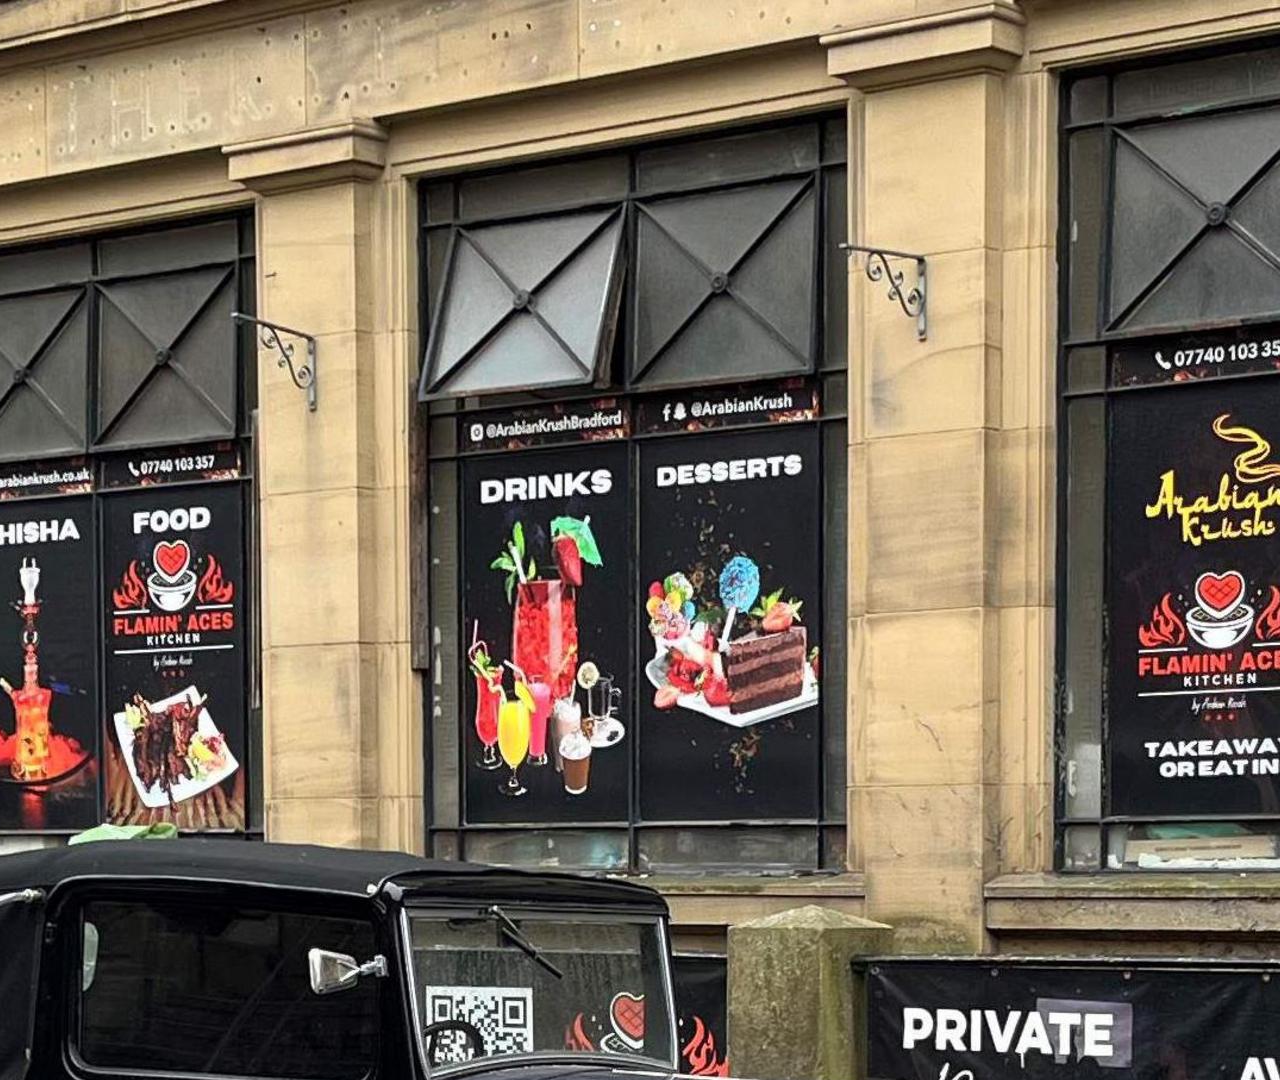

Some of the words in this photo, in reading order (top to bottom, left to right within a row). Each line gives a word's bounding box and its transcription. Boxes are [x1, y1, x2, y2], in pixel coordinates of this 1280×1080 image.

[1175, 347, 1224, 366] 07740
[1229, 343, 1258, 360] 103
[690, 393, 793, 417] @ArabianKrush
[486, 410, 621, 438] @ArabianKrushBradford
[140, 459, 173, 475] 07740
[175, 456, 193, 471] 103
[195, 454, 215, 470] 357
[657, 455, 802, 486] DESSERTS
[481, 470, 612, 503] DRINKS
[134, 507, 210, 533] FOOD
[1180, 508, 1275, 547] Krush
[114, 614, 182, 636] FLAMIN'
[187, 612, 234, 631] ACES
[146, 632, 201, 646] KITCHEN
[1140, 654, 1232, 674] FLAMIN'
[1183, 672, 1258, 687] KITCHEN
[1160, 762, 1194, 777] OR
[1198, 759, 1248, 776] EAT
[1252, 759, 1279, 774] IN
[902, 1007, 1114, 1057] PRIVATE
